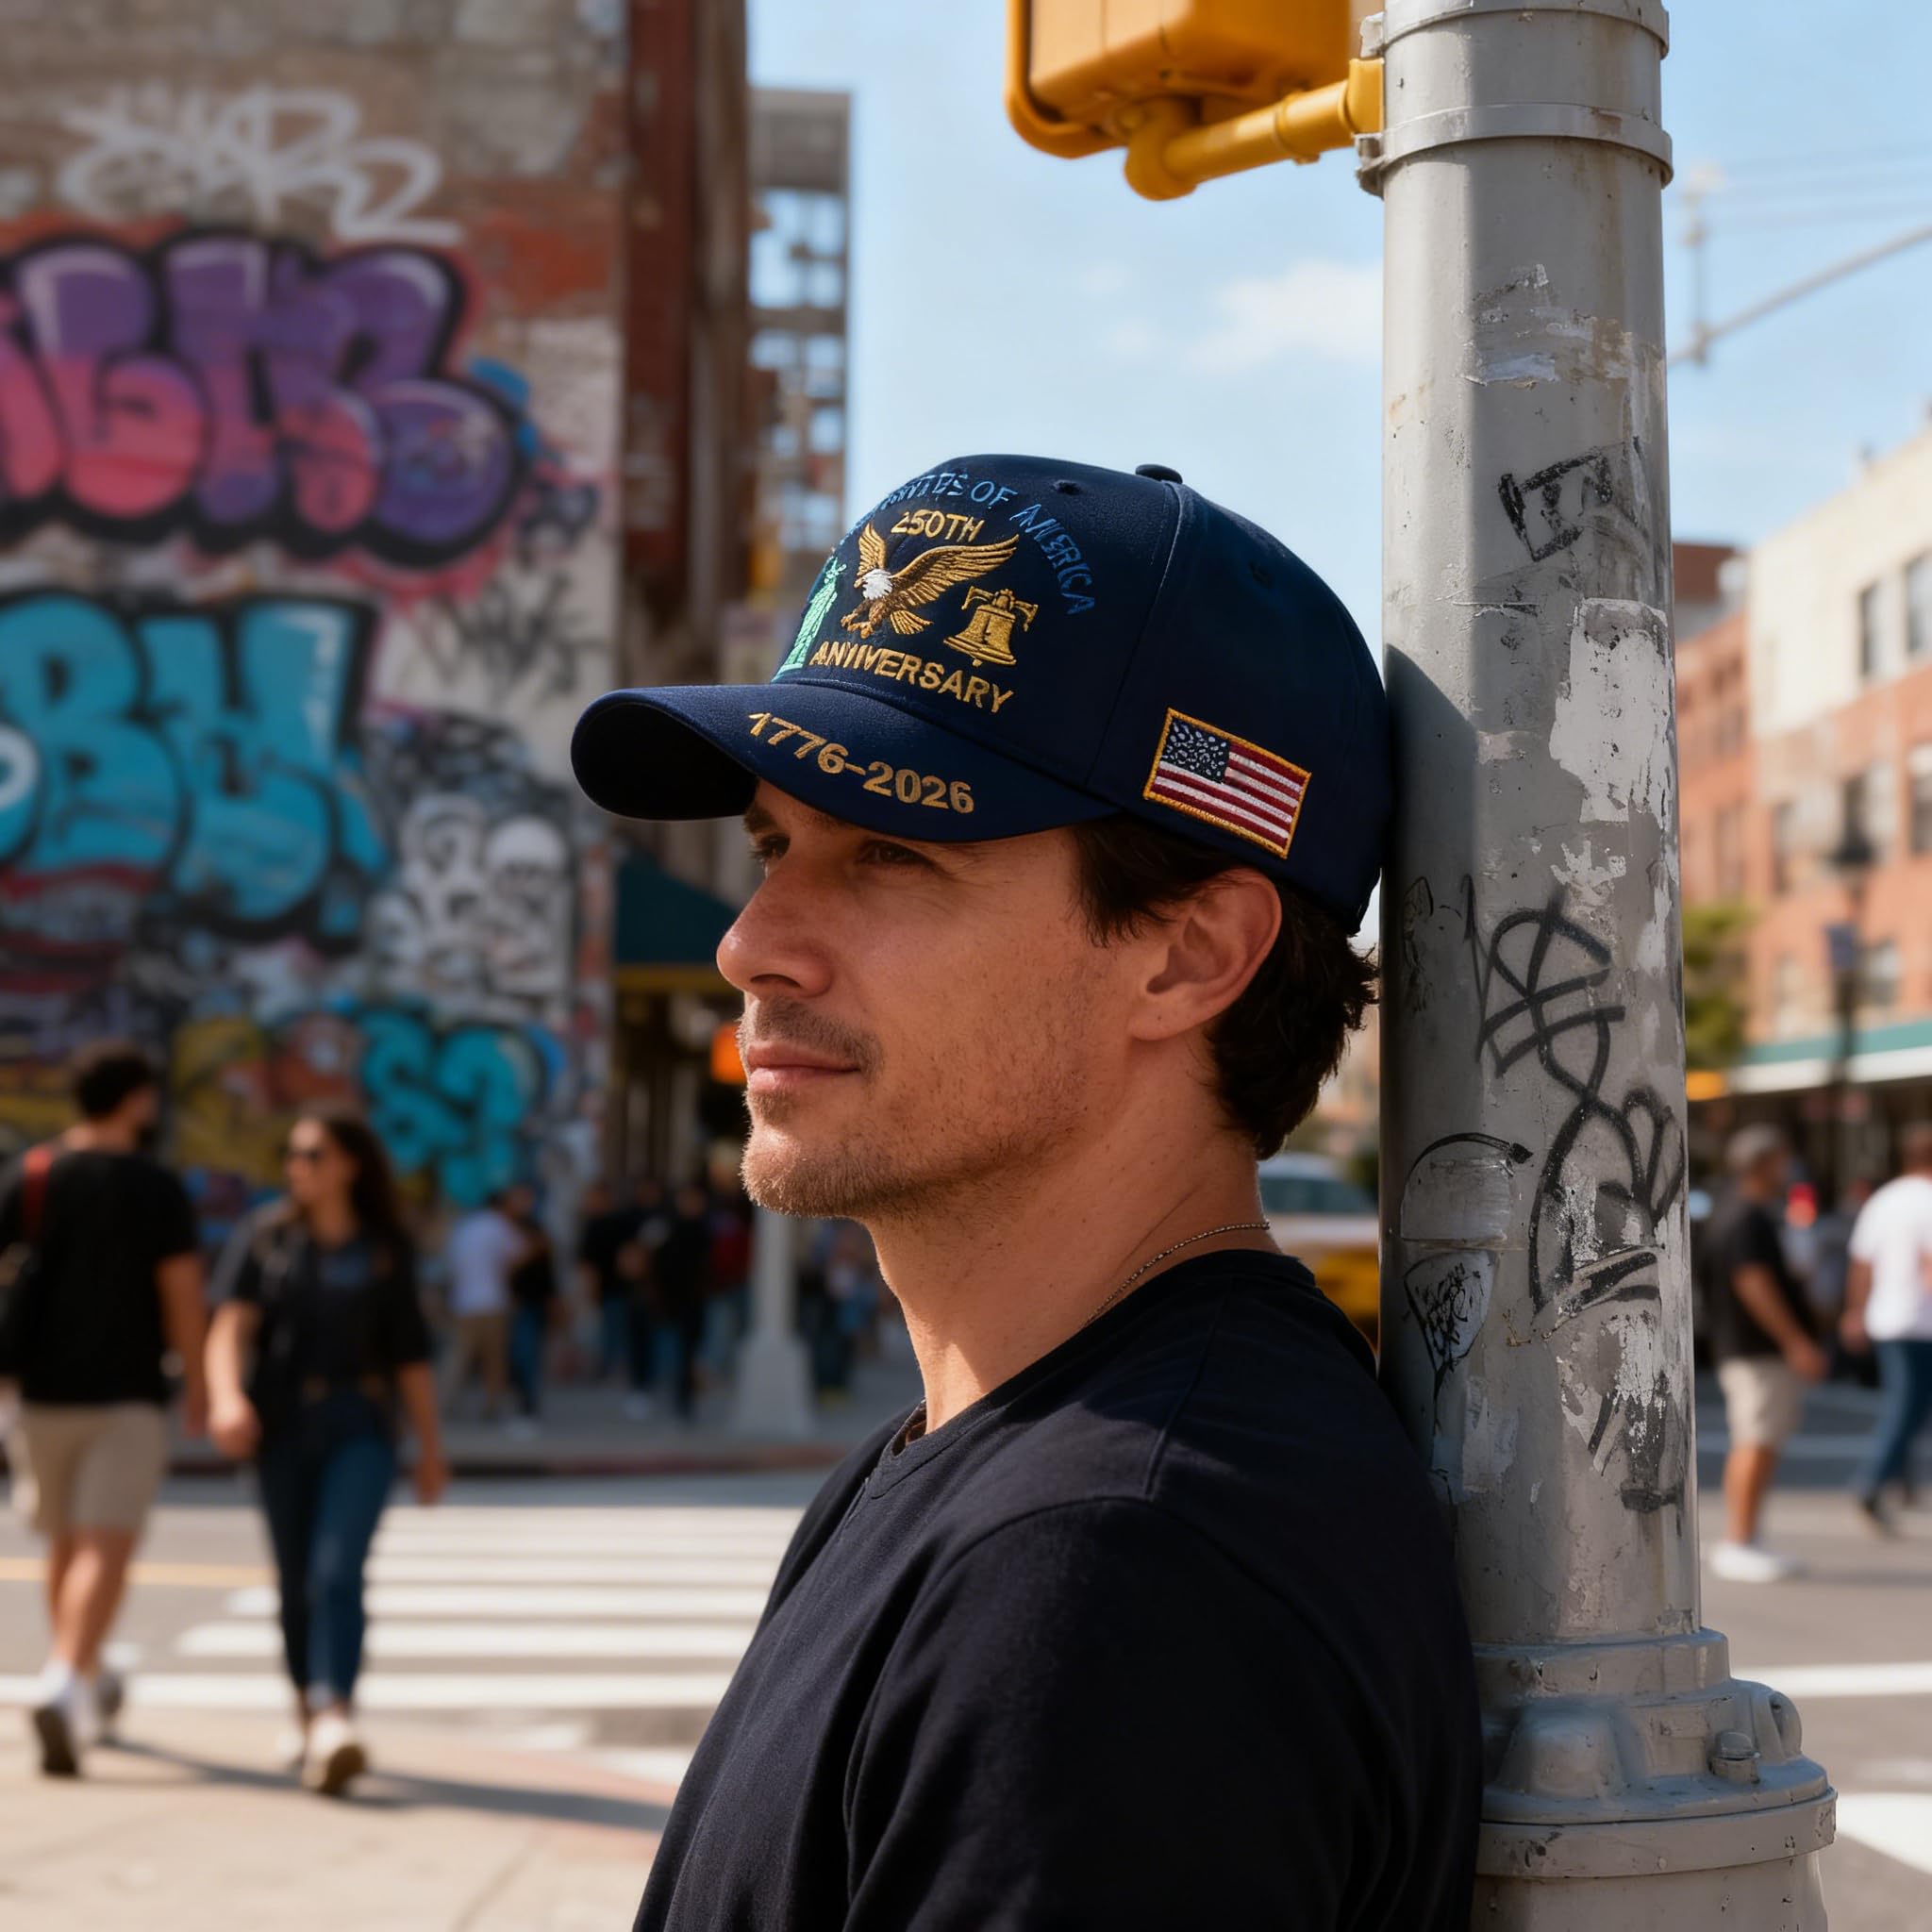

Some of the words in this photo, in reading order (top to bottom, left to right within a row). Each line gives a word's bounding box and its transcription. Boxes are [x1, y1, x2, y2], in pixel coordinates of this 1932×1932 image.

[970, 480, 1019, 509] OF
[891, 508, 985, 543] 250TH
[747, 711, 975, 814] 1776-2026
